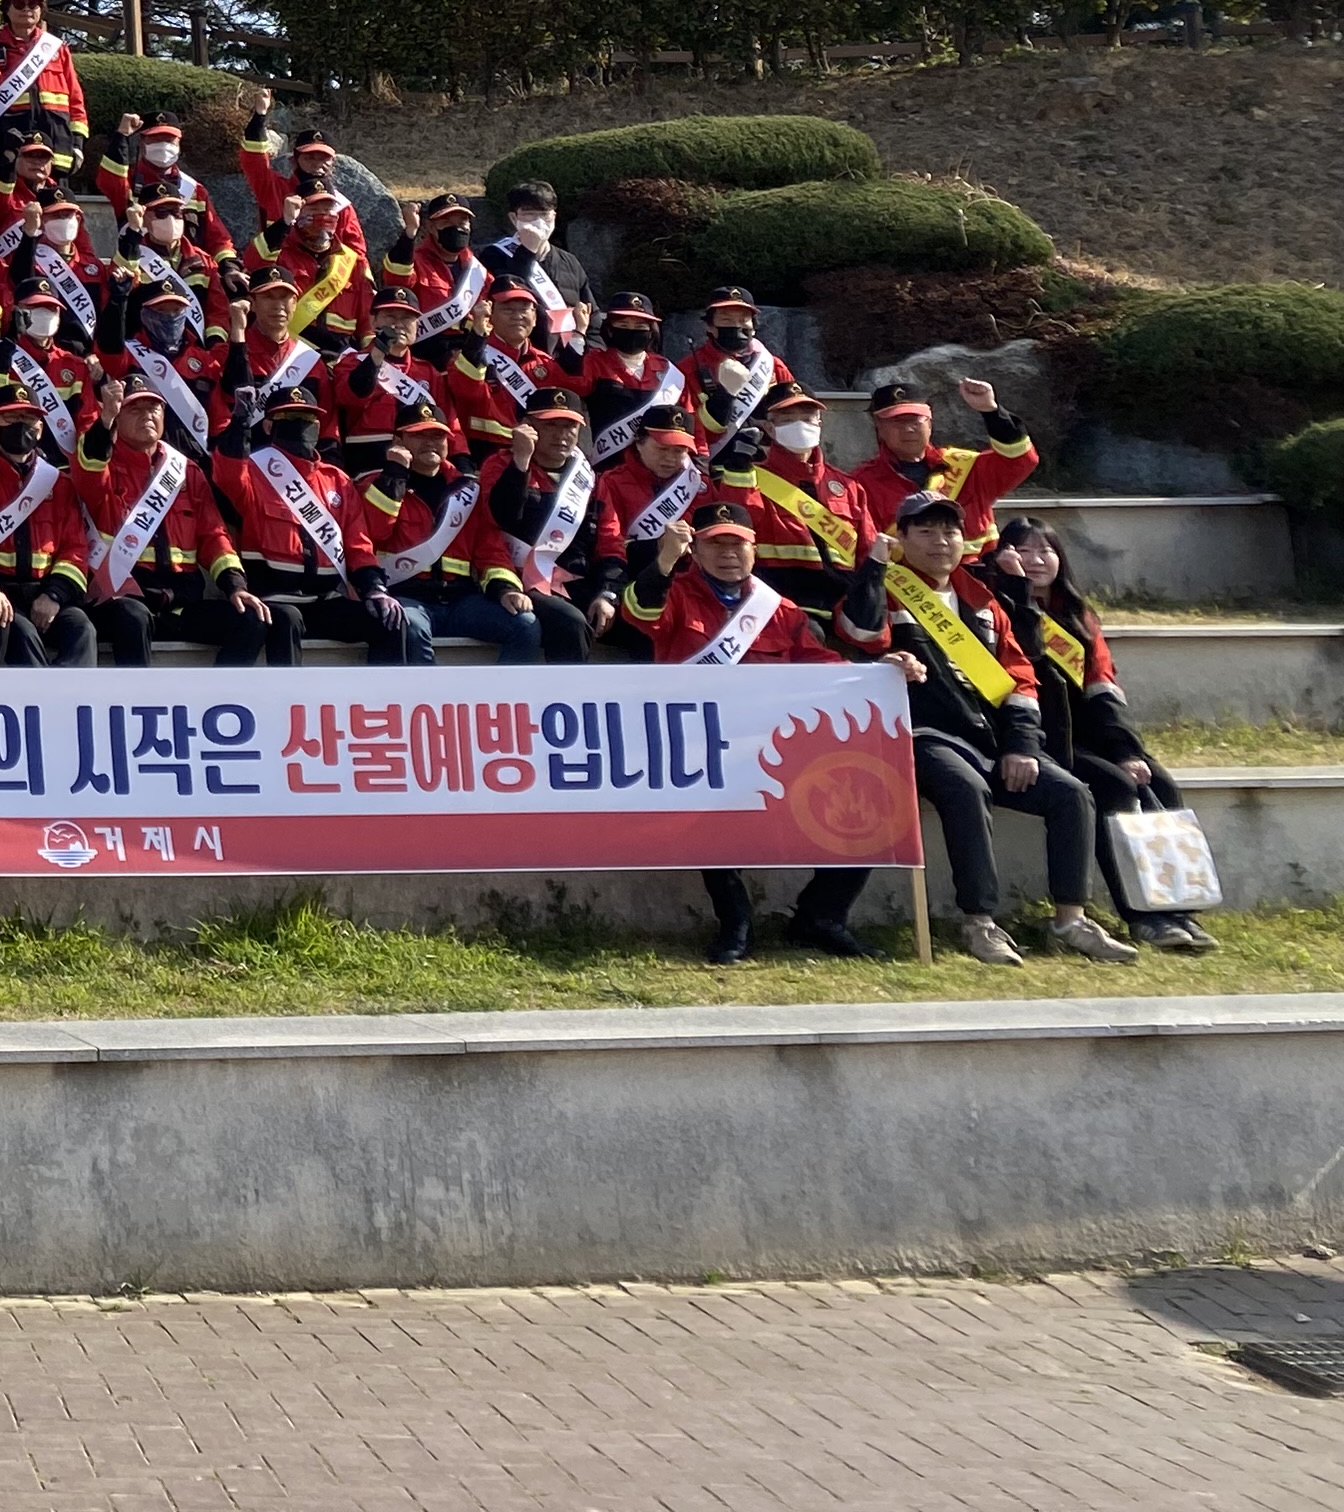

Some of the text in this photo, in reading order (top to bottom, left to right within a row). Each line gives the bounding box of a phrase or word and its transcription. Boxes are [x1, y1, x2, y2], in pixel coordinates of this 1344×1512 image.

[416, 302, 464, 338] 산불조
[13, 354, 60, 413] 불조심
[596, 412, 648, 454] 불조심
[284, 479, 345, 564] 산불조심
[630, 483, 691, 540] 산불조
[818, 515, 855, 550] 산불
[70, 703, 262, 796] 시작은
[280, 701, 731, 794] 산불예방입니다
